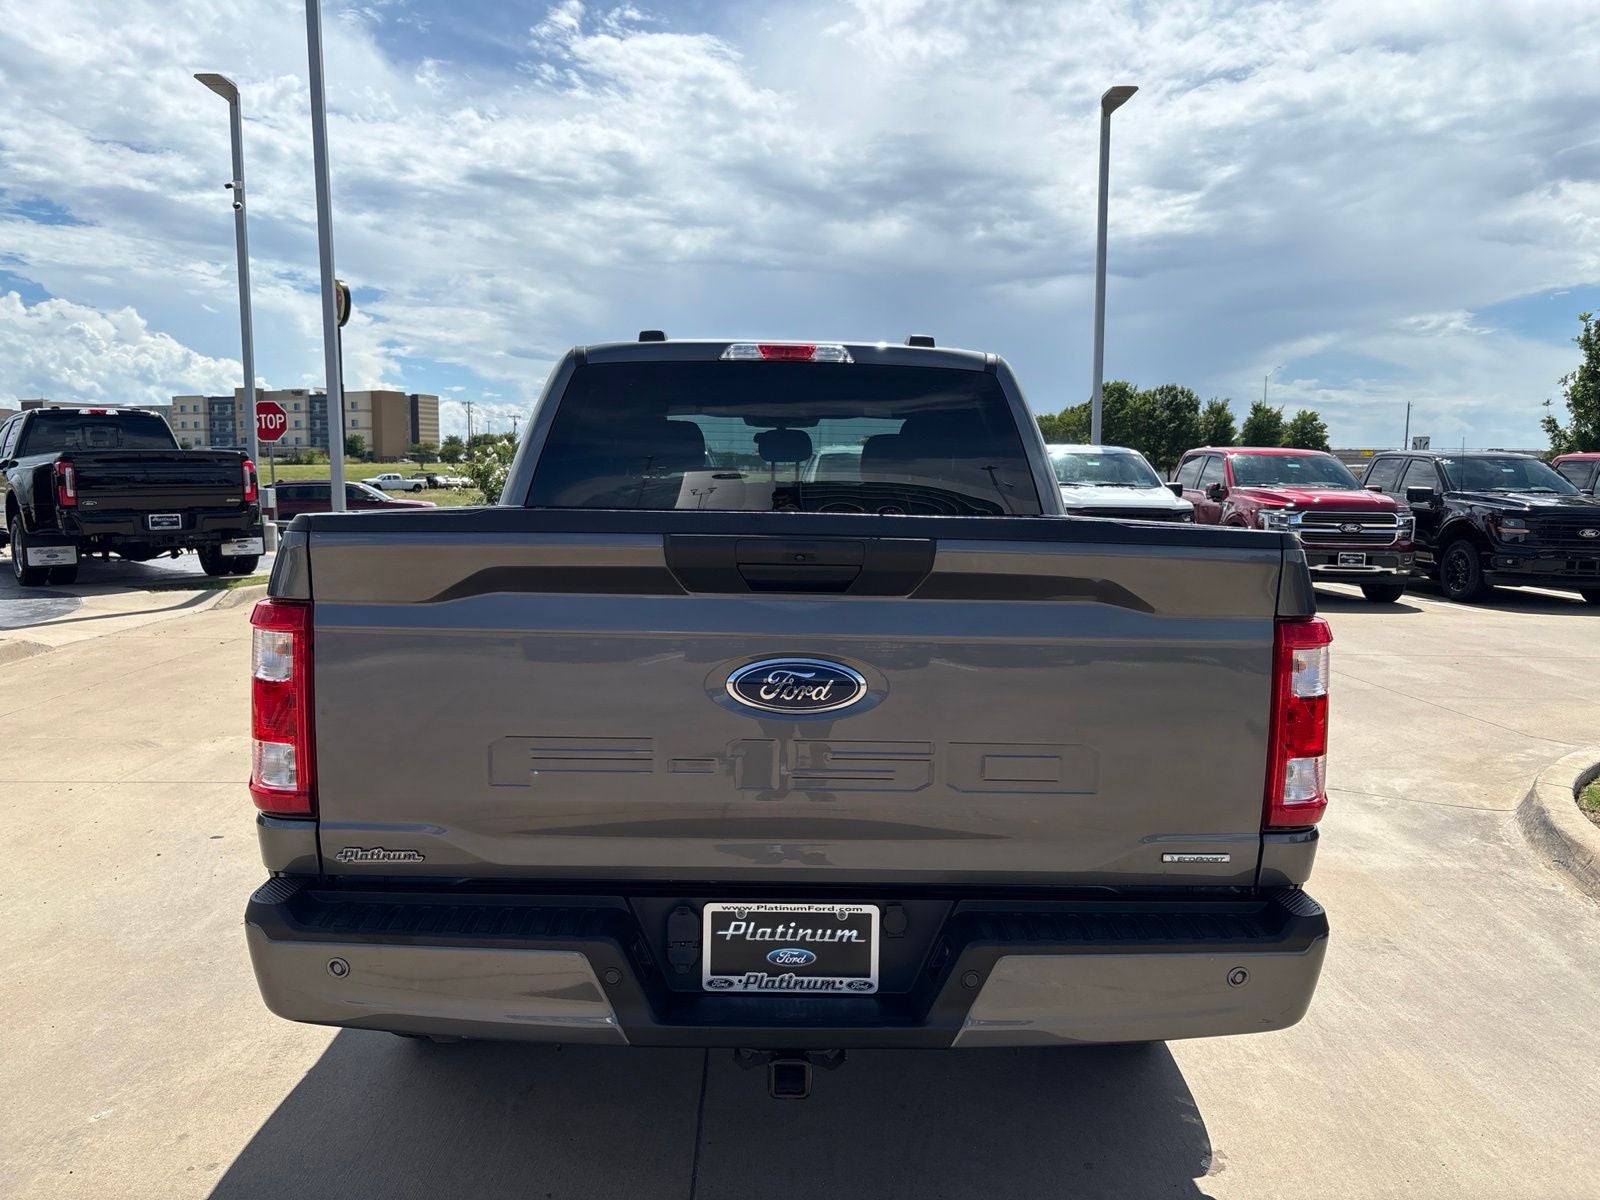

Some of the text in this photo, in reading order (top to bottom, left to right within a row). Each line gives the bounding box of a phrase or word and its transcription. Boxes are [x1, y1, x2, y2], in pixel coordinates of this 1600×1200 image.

[760, 670, 834, 701] Ford
[336, 847, 424, 863] Platinum
[721, 904, 863, 913] www.PlatinumFord.com
[716, 921, 867, 943] Platinum
[776, 951, 807, 964] Ford
[742, 973, 844, 991] Platinum
